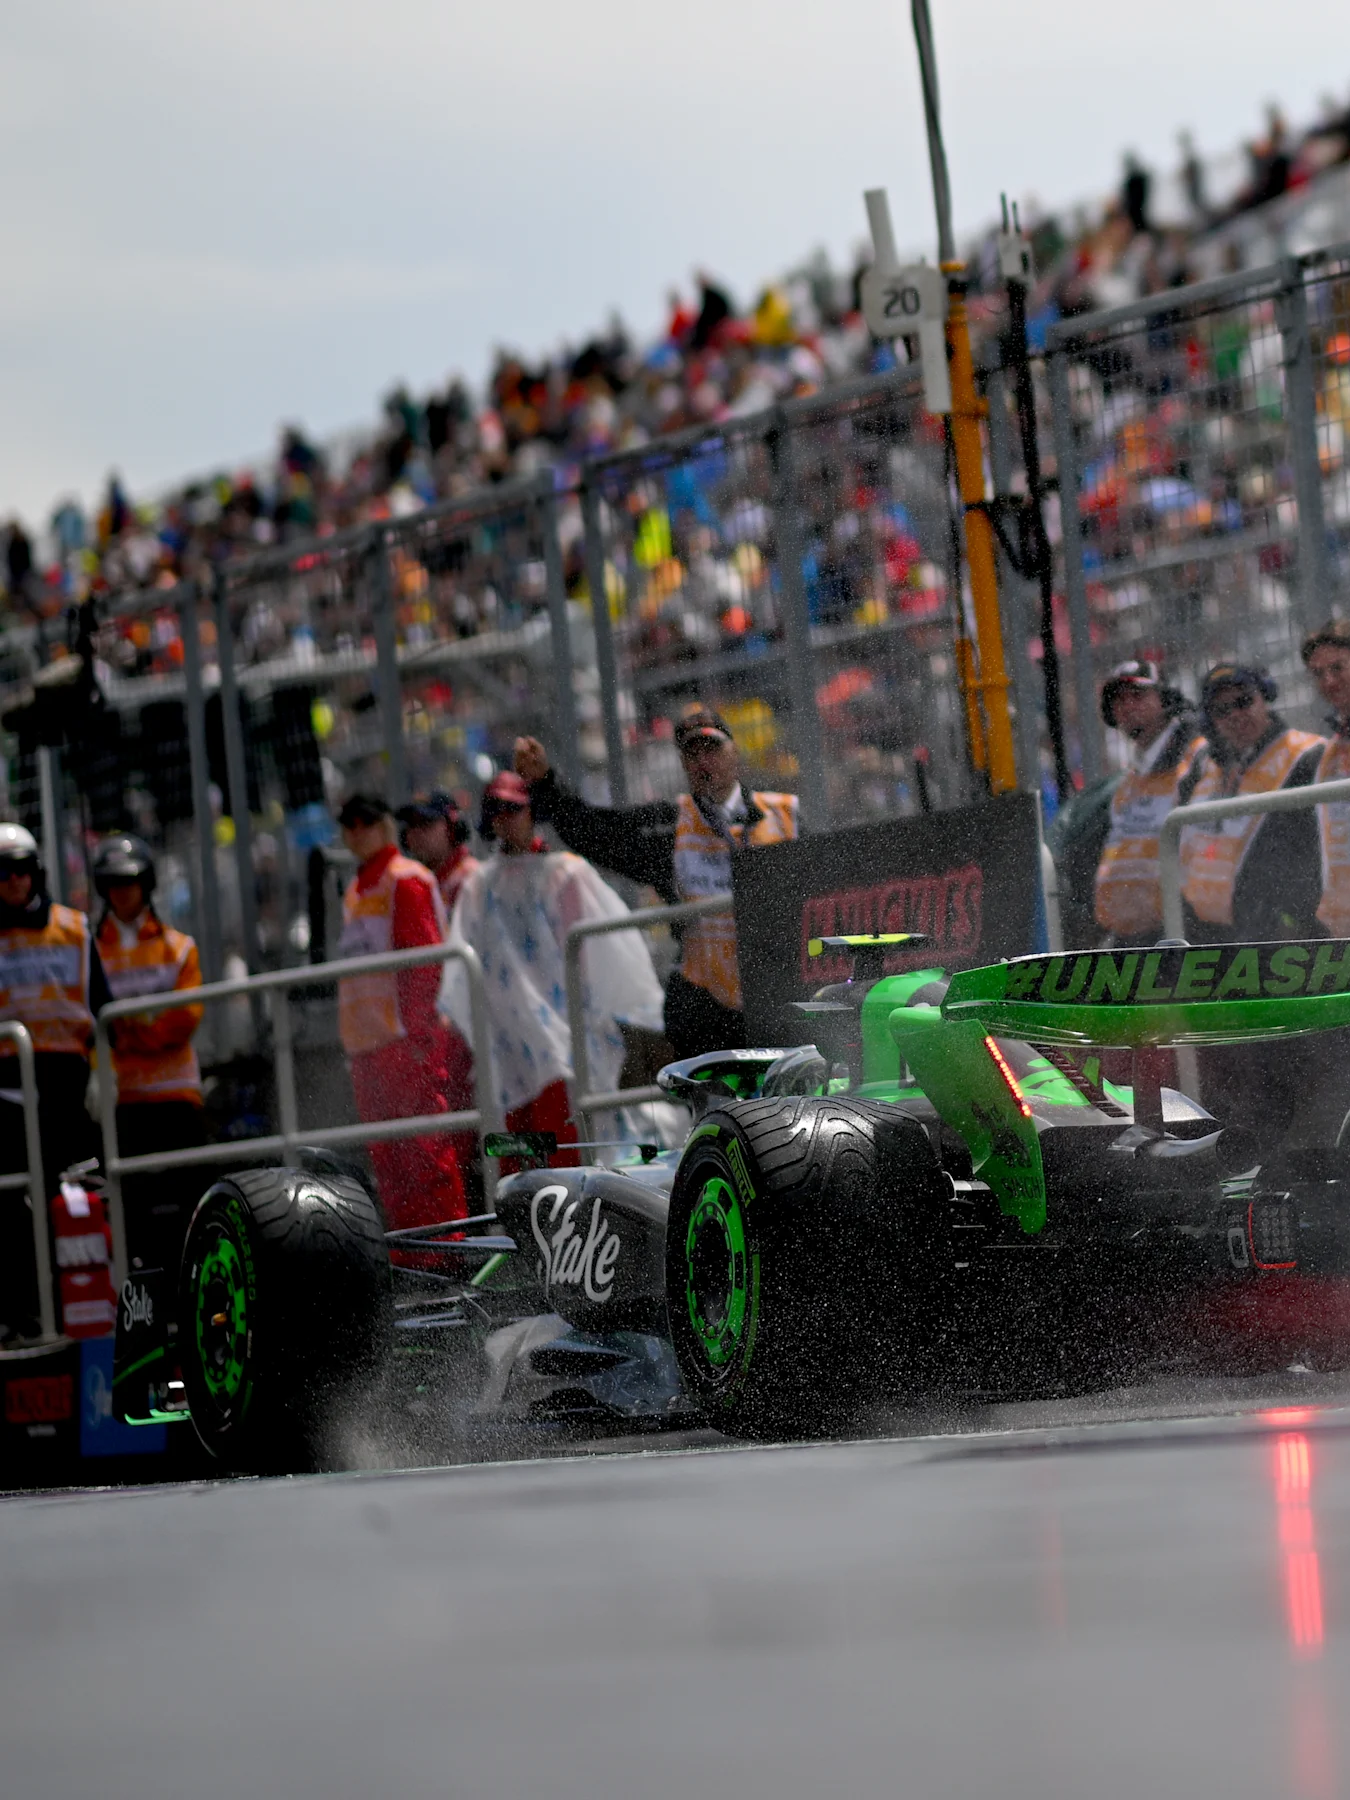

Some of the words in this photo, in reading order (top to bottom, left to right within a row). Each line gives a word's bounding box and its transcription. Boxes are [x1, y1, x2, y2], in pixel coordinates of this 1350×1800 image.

[883, 287, 921, 318] 20
[530, 1184, 620, 1302] Stake
[122, 1278, 154, 1332] Stake
